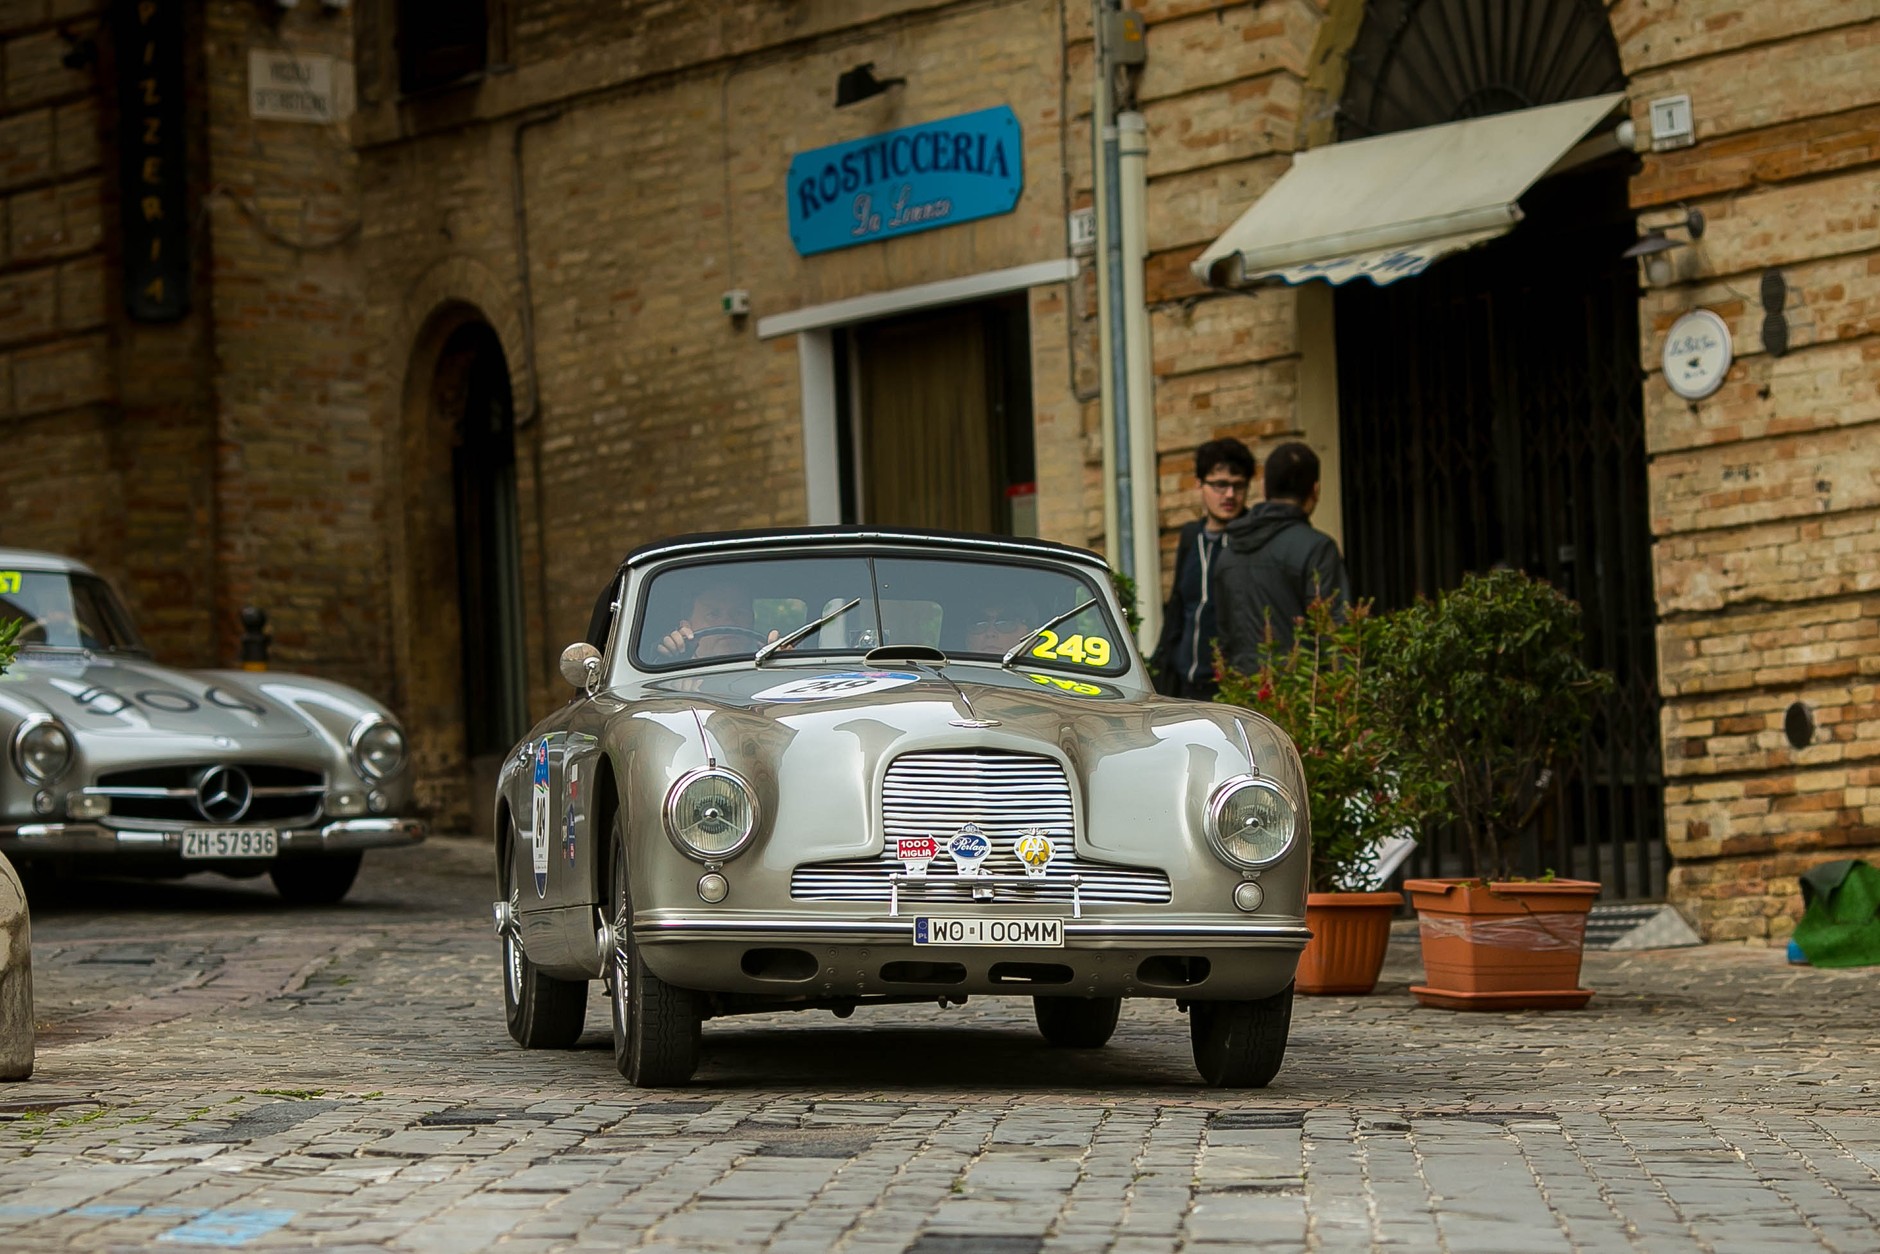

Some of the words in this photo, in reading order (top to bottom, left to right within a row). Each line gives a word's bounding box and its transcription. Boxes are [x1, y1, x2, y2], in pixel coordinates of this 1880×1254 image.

[139, 0, 163, 304] PIZZERIA
[798, 131, 1010, 220] ROSTICCERIA
[1032, 629, 1111, 668] 249
[783, 679, 877, 695] 249
[900, 849, 932, 858] MIGLIA
[901, 839, 930, 849] 1000
